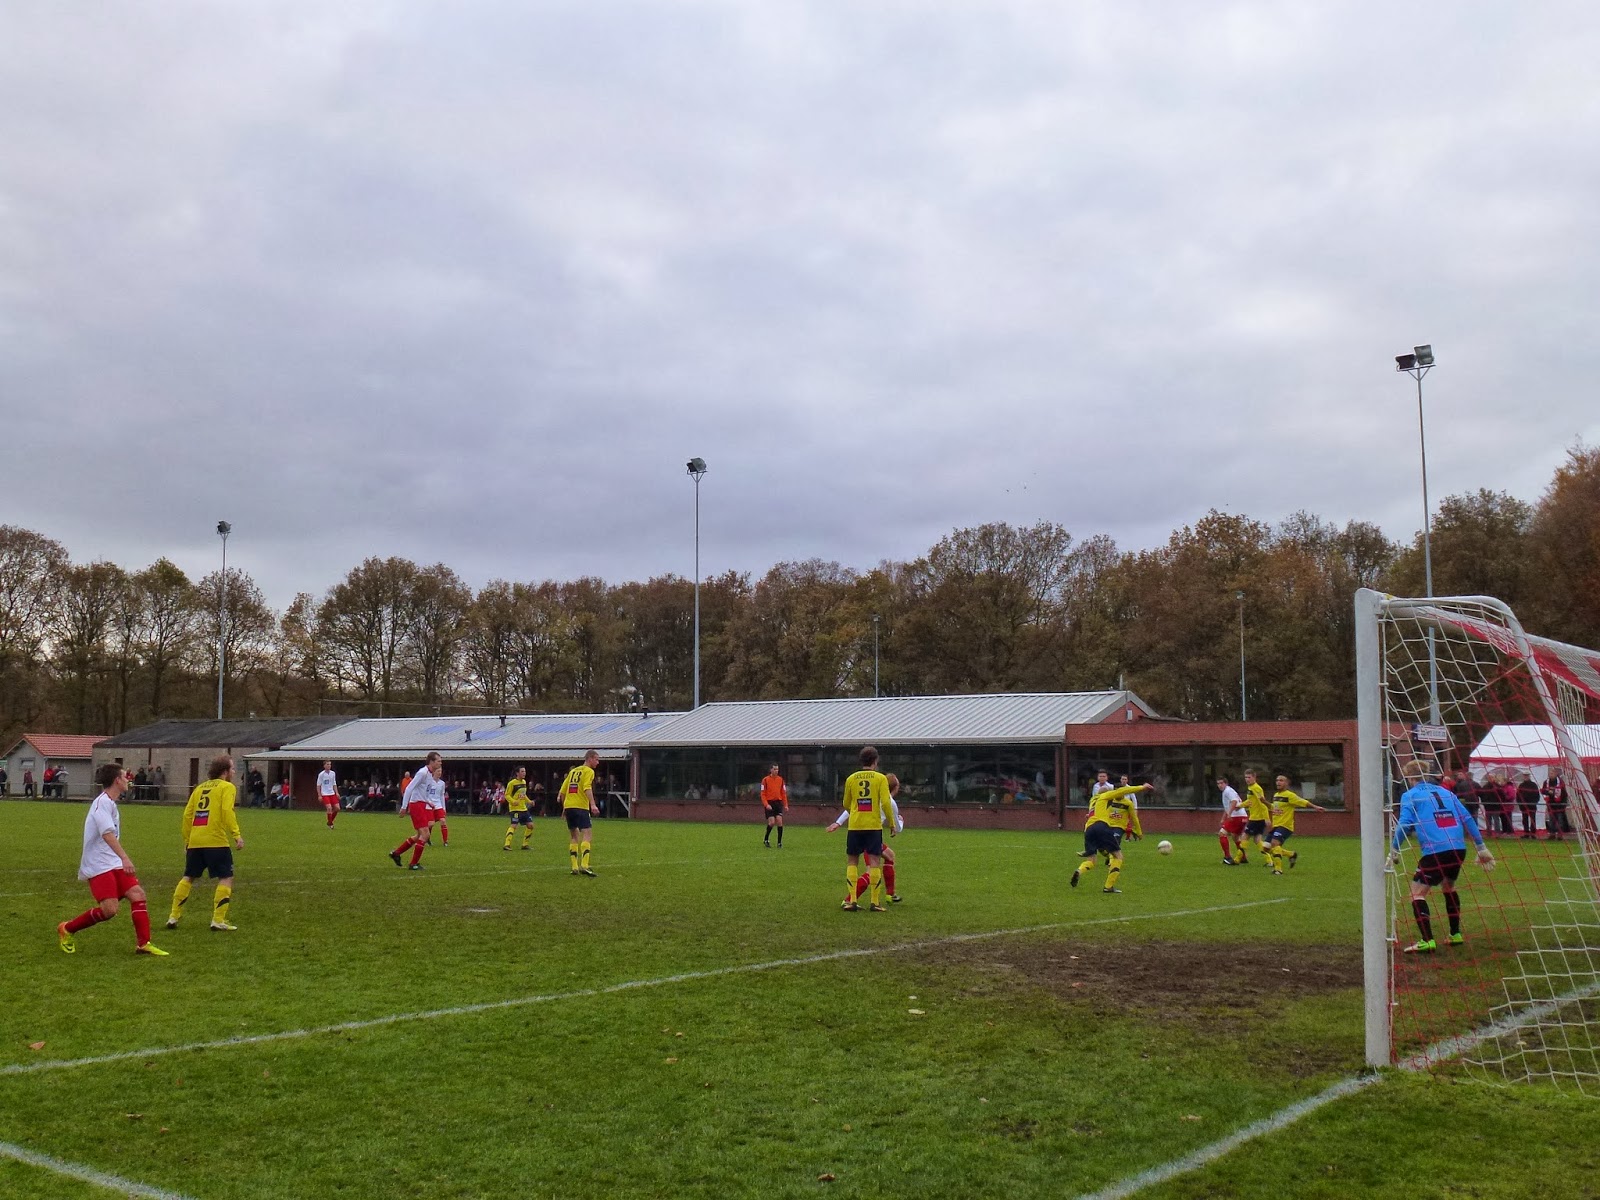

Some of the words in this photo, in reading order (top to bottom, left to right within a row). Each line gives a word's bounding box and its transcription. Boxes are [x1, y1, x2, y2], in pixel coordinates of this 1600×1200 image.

[570, 771, 582, 783] 13
[858, 780, 870, 797] 3
[198, 789, 211, 809] 5
[1430, 791, 1447, 810] 1
